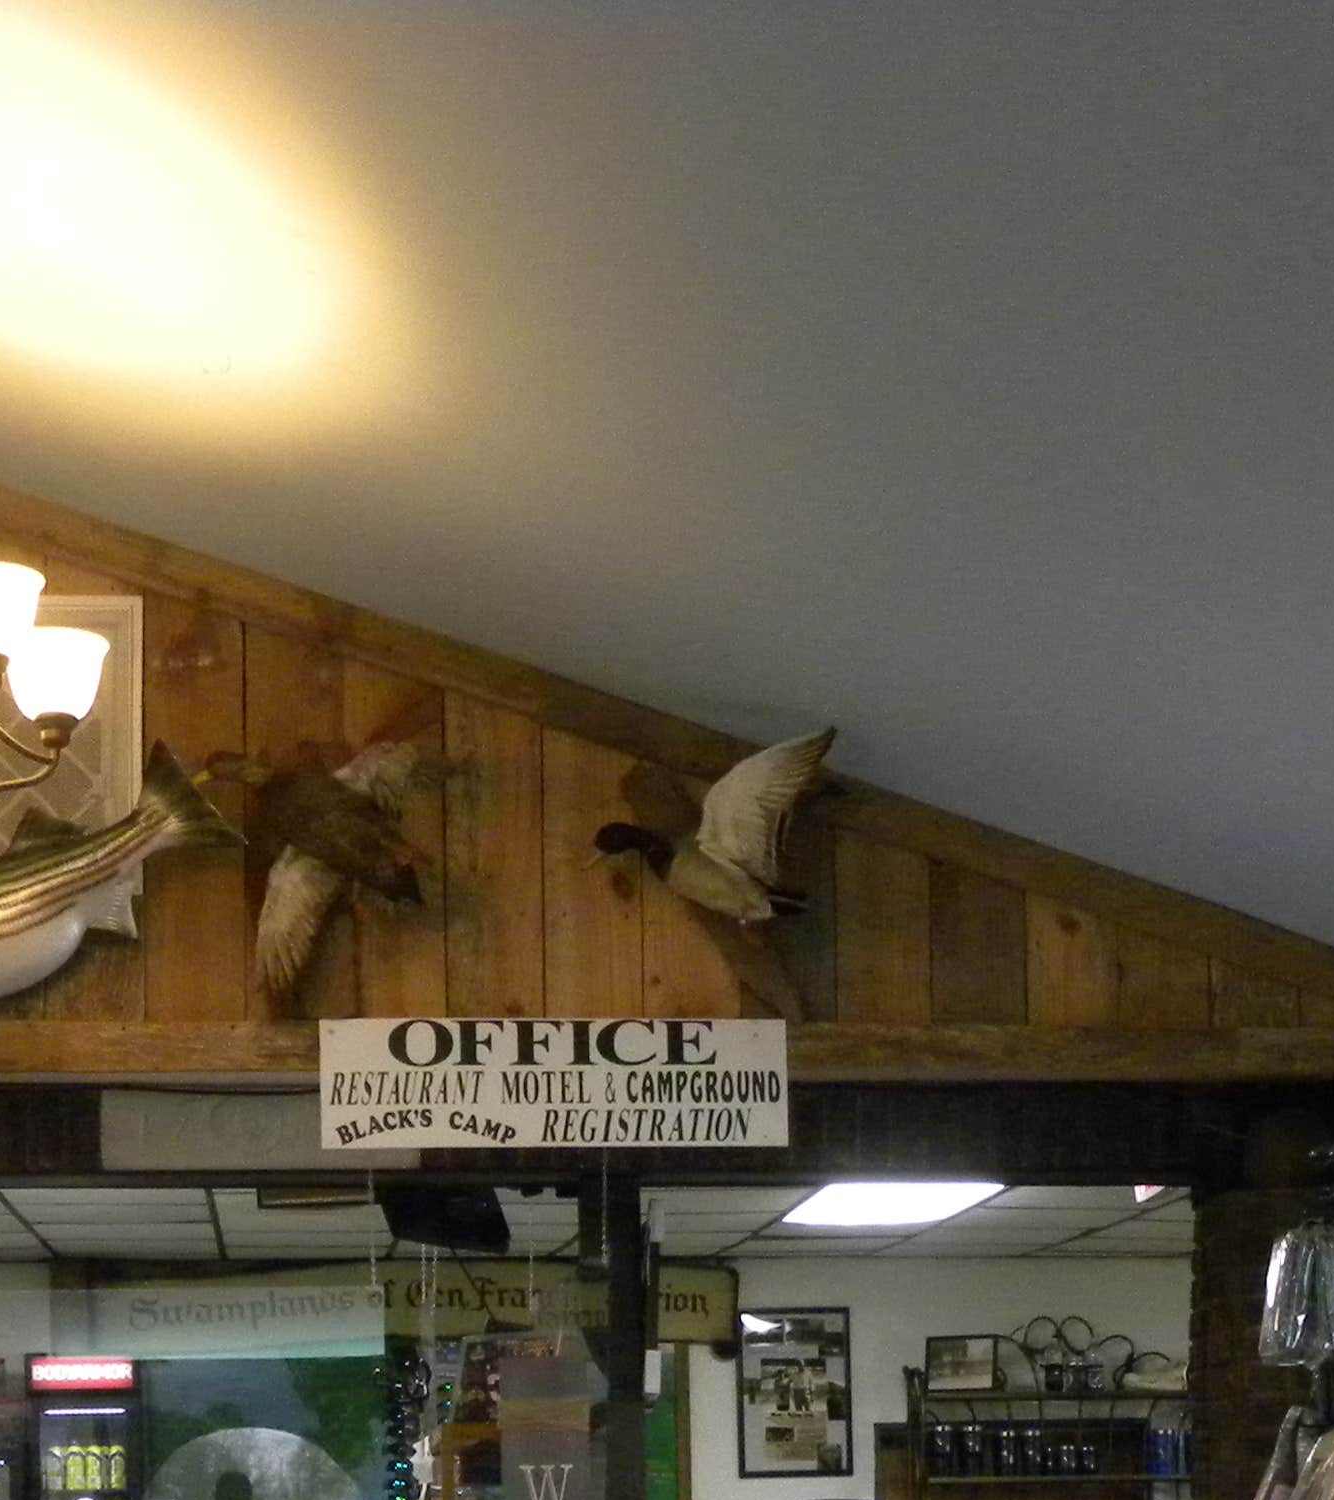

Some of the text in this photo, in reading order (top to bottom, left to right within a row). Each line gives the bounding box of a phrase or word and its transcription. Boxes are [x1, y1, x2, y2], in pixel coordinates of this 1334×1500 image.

[387, 1019, 717, 1067] OFFICE
[330, 1070, 782, 1106] RESTAURANT MOTEL & CAMPGROUND
[336, 1107, 753, 1146] BLACK'S CAMP REGISTRATION
